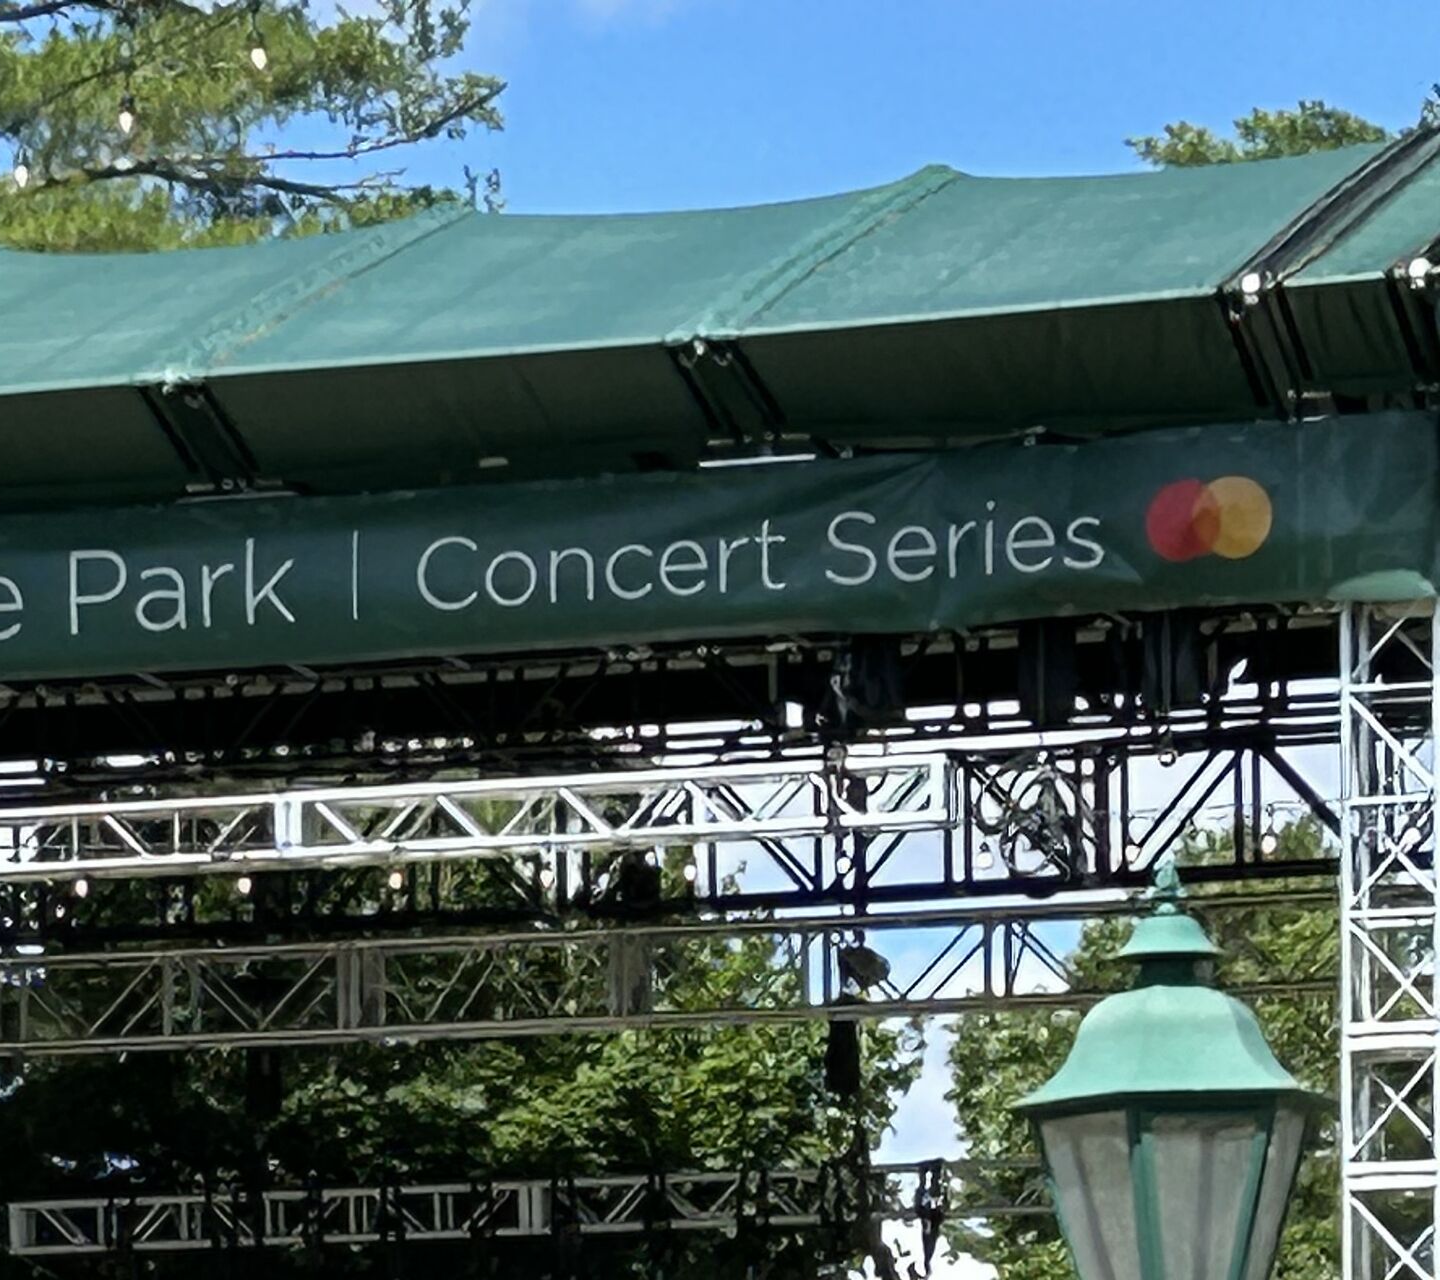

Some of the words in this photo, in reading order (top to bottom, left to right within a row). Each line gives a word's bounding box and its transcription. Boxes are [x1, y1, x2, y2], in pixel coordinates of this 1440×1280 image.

[69, 537, 295, 636] Park
[416, 518, 787, 610] Concert
[824, 500, 1106, 586] Series
